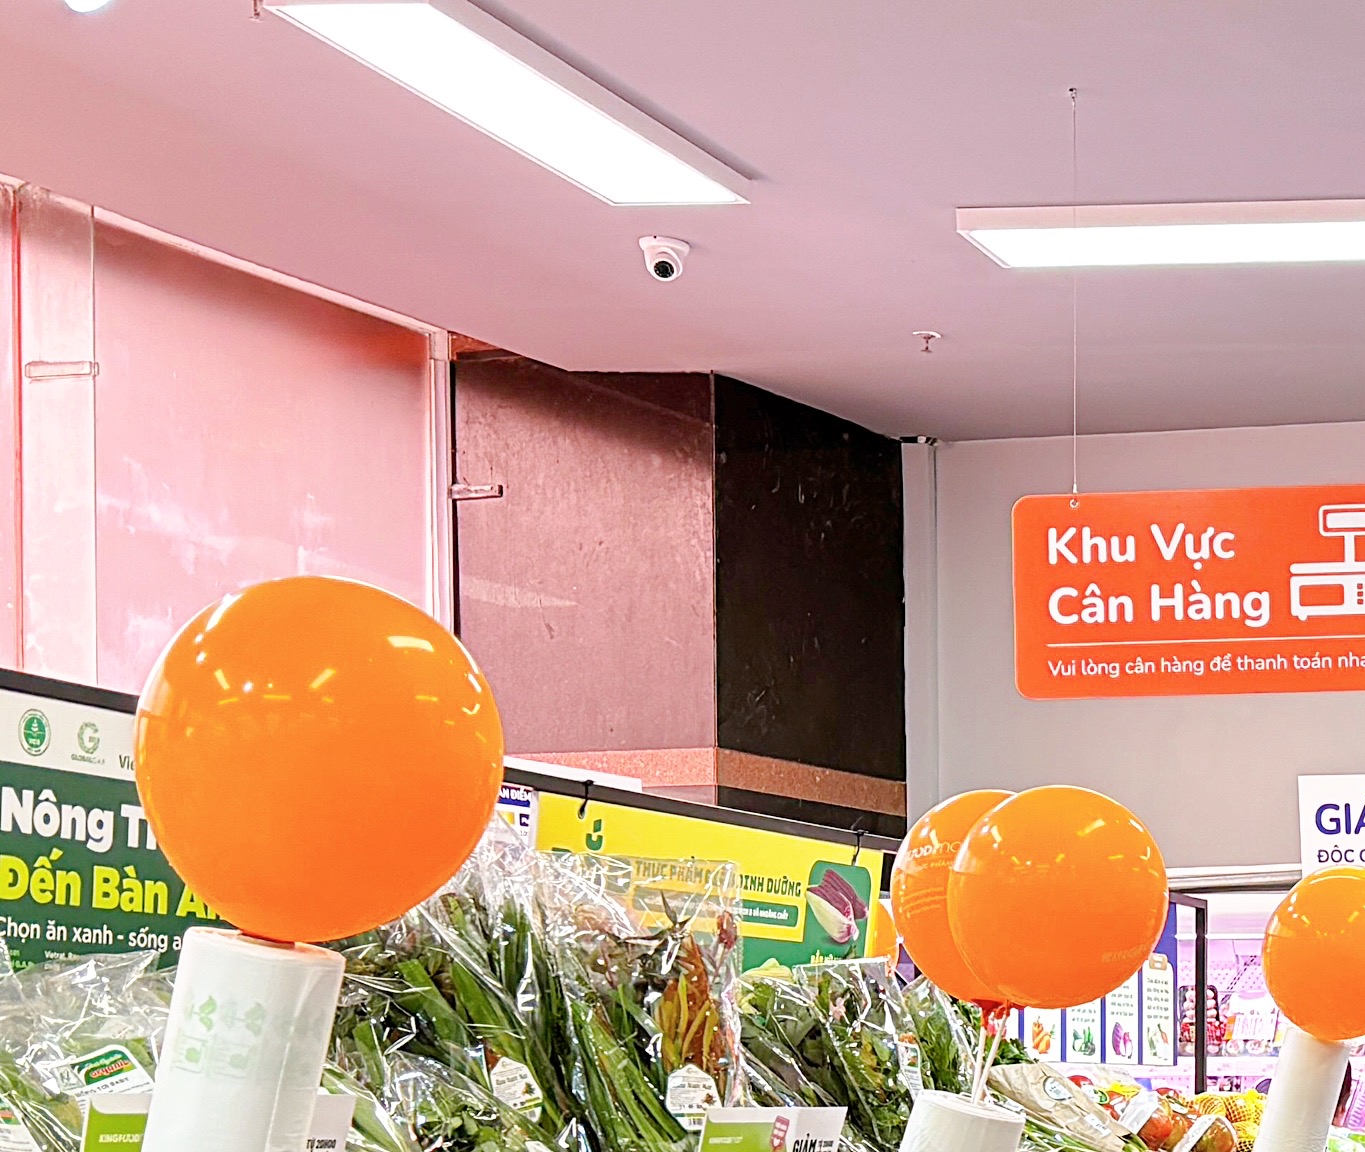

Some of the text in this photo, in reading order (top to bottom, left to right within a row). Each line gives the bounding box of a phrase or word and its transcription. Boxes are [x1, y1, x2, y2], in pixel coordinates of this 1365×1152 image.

[1047, 523, 1235, 570] Khu Vực
[1048, 579, 1270, 627] Cân Hàng
[1048, 659, 1076, 676] Vui
[1081, 658, 1120, 678] lòng
[1124, 657, 1155, 675] cân
[1160, 655, 1205, 676] hàng
[1210, 653, 1233, 672] để
[1236, 653, 1287, 672] thanh
[1292, 651, 1332, 670] toán
[1, 786, 114, 852] Nông
[0, 847, 81, 906] Đến
[92, 865, 168, 915] Bàn
[767, 876, 801, 897] DƯỠNG
[0, 916, 41, 943] Chọn
[46, 921, 68, 942] ăn
[72, 925, 113, 945] xanh
[128, 927, 169, 953] sống
